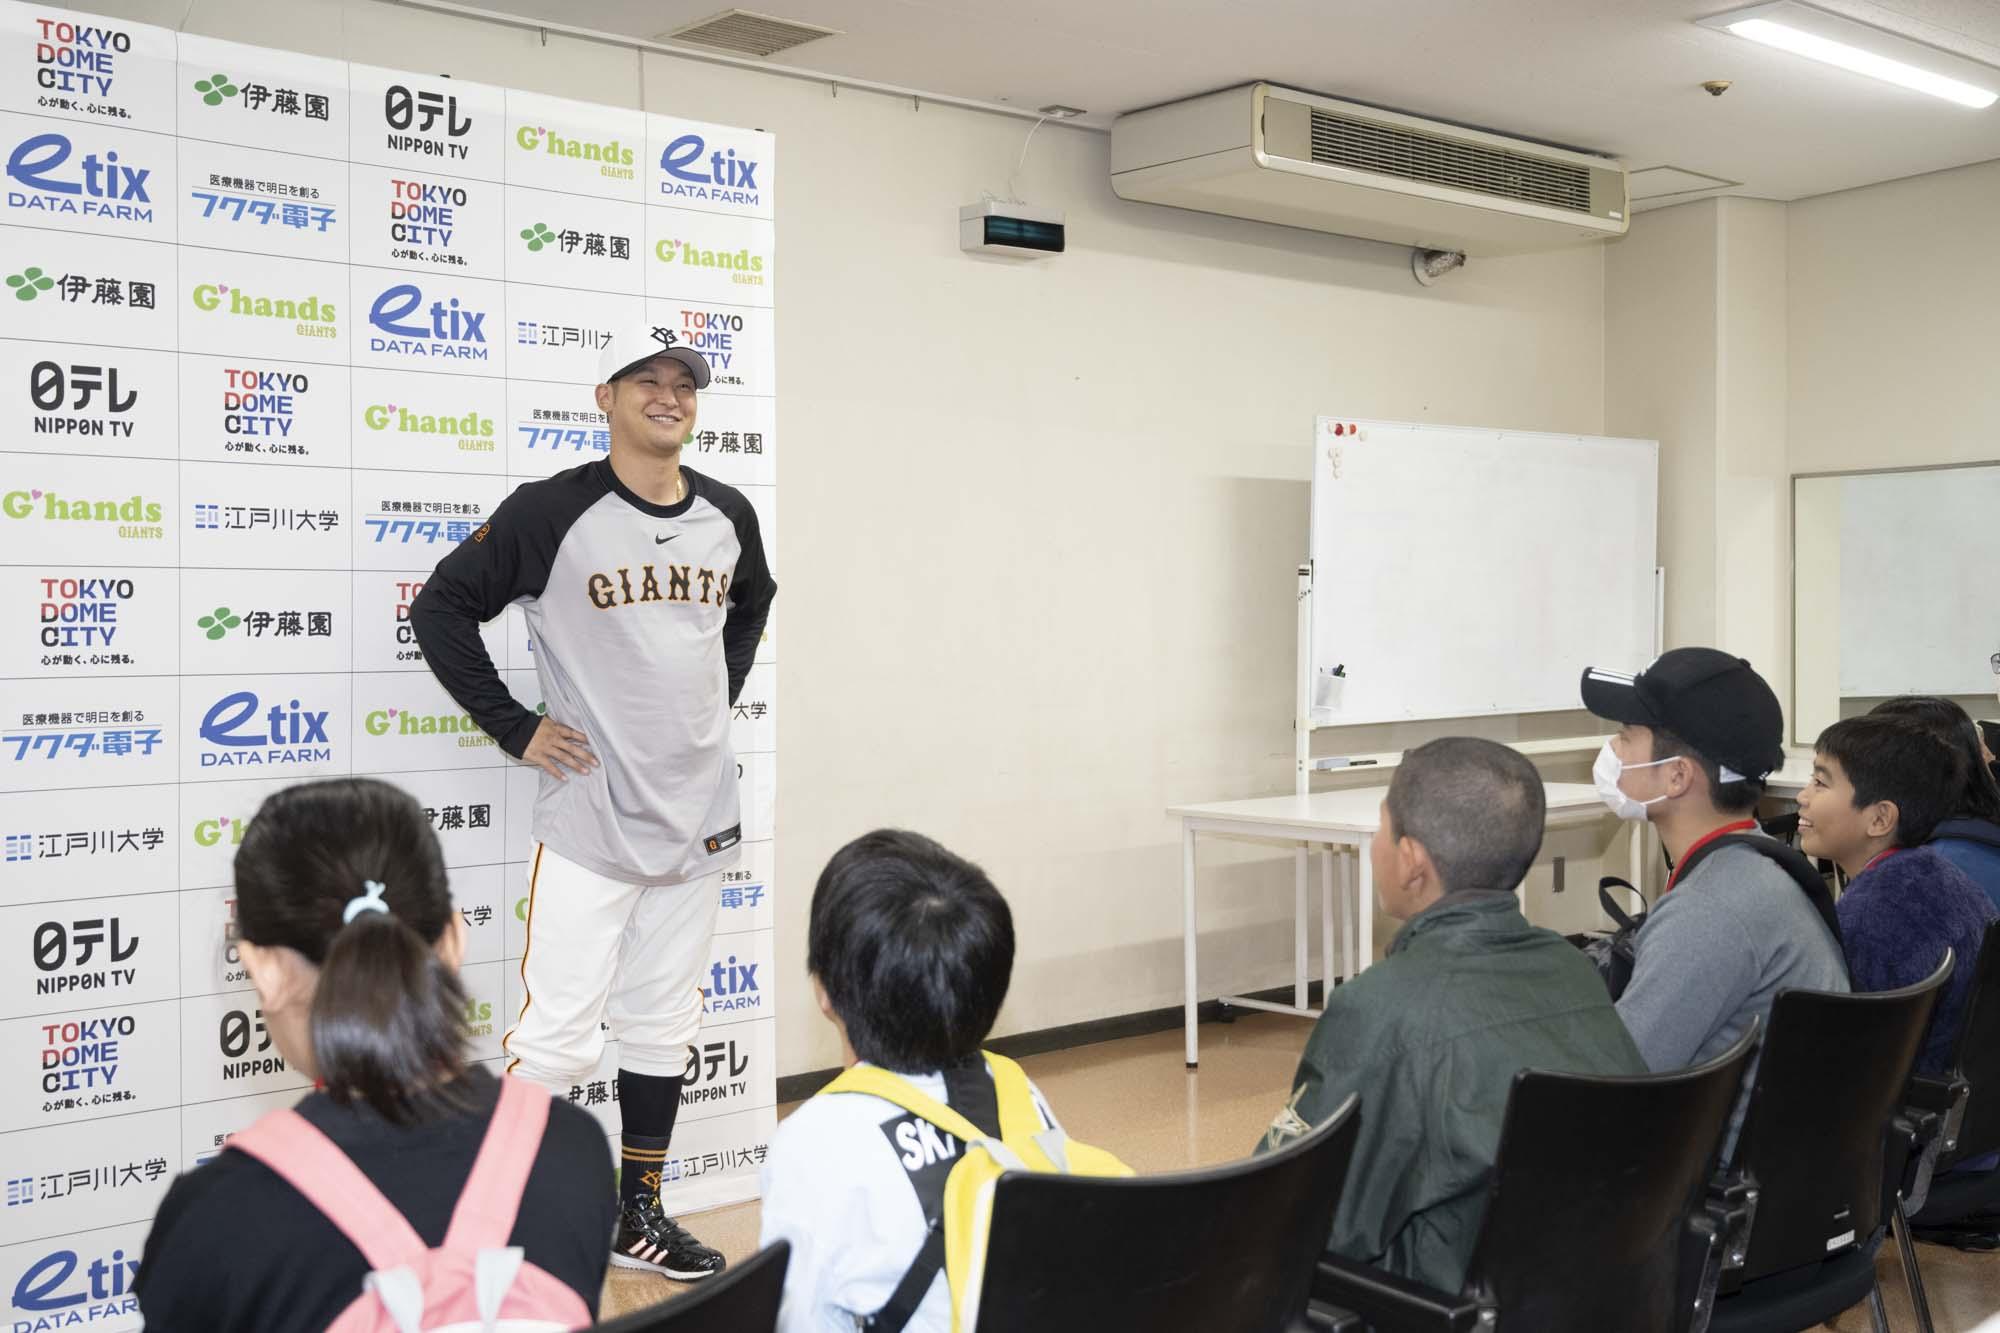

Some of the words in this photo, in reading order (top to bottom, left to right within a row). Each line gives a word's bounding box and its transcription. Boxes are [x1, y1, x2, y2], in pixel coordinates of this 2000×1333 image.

[36, 18, 131, 53] TOKYO
[37, 43, 114, 75] DOME
[37, 67, 113, 97] CITY
[38, 96, 131, 119] 心が動く、心に残る。
[240, 82, 329, 122] 伊藤園
[385, 85, 472, 137] 日テレ
[388, 134, 444, 157] NIPPON
[448, 143, 468, 160] TV
[6, 133, 151, 203] etix
[660, 135, 758, 189] etix
[210, 174, 319, 199] 医療機器で明日を創る
[391, 180, 467, 207] TOKYO
[661, 182, 708, 199] DATA
[712, 189, 758, 205] FARM
[8, 192, 78, 214] DATA
[83, 201, 152, 223] FARM
[192, 192, 337, 233] フクダ電子
[391, 201, 453, 227] DOME
[391, 223, 453, 248] CITY
[557, 229, 630, 260] 伊藤園
[392, 248, 467, 266] 心が動く、心に残る。
[56, 273, 155, 310] 伊藤園
[369, 284, 486, 343] etix
[680, 310, 743, 332] TOKYO
[371, 338, 427, 355] DATA
[432, 344, 487, 360] FARM
[31, 361, 138, 413] 日テレ
[224, 369, 308, 393] TOKYO
[224, 392, 293, 415] DOME
[533, 409, 612, 423] 医療機器で明日を
[34, 416, 103, 436] NIPPON
[109, 420, 134, 437] TV
[225, 414, 293, 437] CITY
[225, 441, 309, 455] 心が動く、心に残る。
[696, 430, 762, 455] 伊藤園
[225, 507, 338, 531] 江戸川大学
[381, 501, 480, 515] 医療機器で明日を創る
[41, 579, 134, 599] TOKYO
[588, 563, 729, 610] GIANTS
[41, 602, 117, 623] DOME
[243, 610, 332, 638] 伊藤園
[41, 626, 116, 647] CITY
[41, 653, 135, 666] 心が動く、心に残る。
[22, 710, 145, 726] 医療機器で明日を創る
[199, 691, 329, 747] etix
[2, 729, 163, 760] フクダ電子
[201, 751, 263, 767] DATA
[268, 748, 330, 764] FARM
[39, 827, 164, 858] 江戸川大学
[33, 917, 139, 972] 日テレ
[37, 971, 105, 995] NIPPON
[111, 968, 136, 986] TV
[703, 955, 759, 998] tix
[713, 995, 760, 1013] FARM
[42, 1016, 135, 1045] TOKYO
[42, 1040, 118, 1070] DOME
[42, 1064, 118, 1093] CITY
[730, 1082, 746, 1096] TV
[42, 1090, 136, 1112] 心が動く、心に残る。
[684, 1144, 769, 1178] 江戸川大学
[41, 1157, 167, 1200] 江戸川大学
